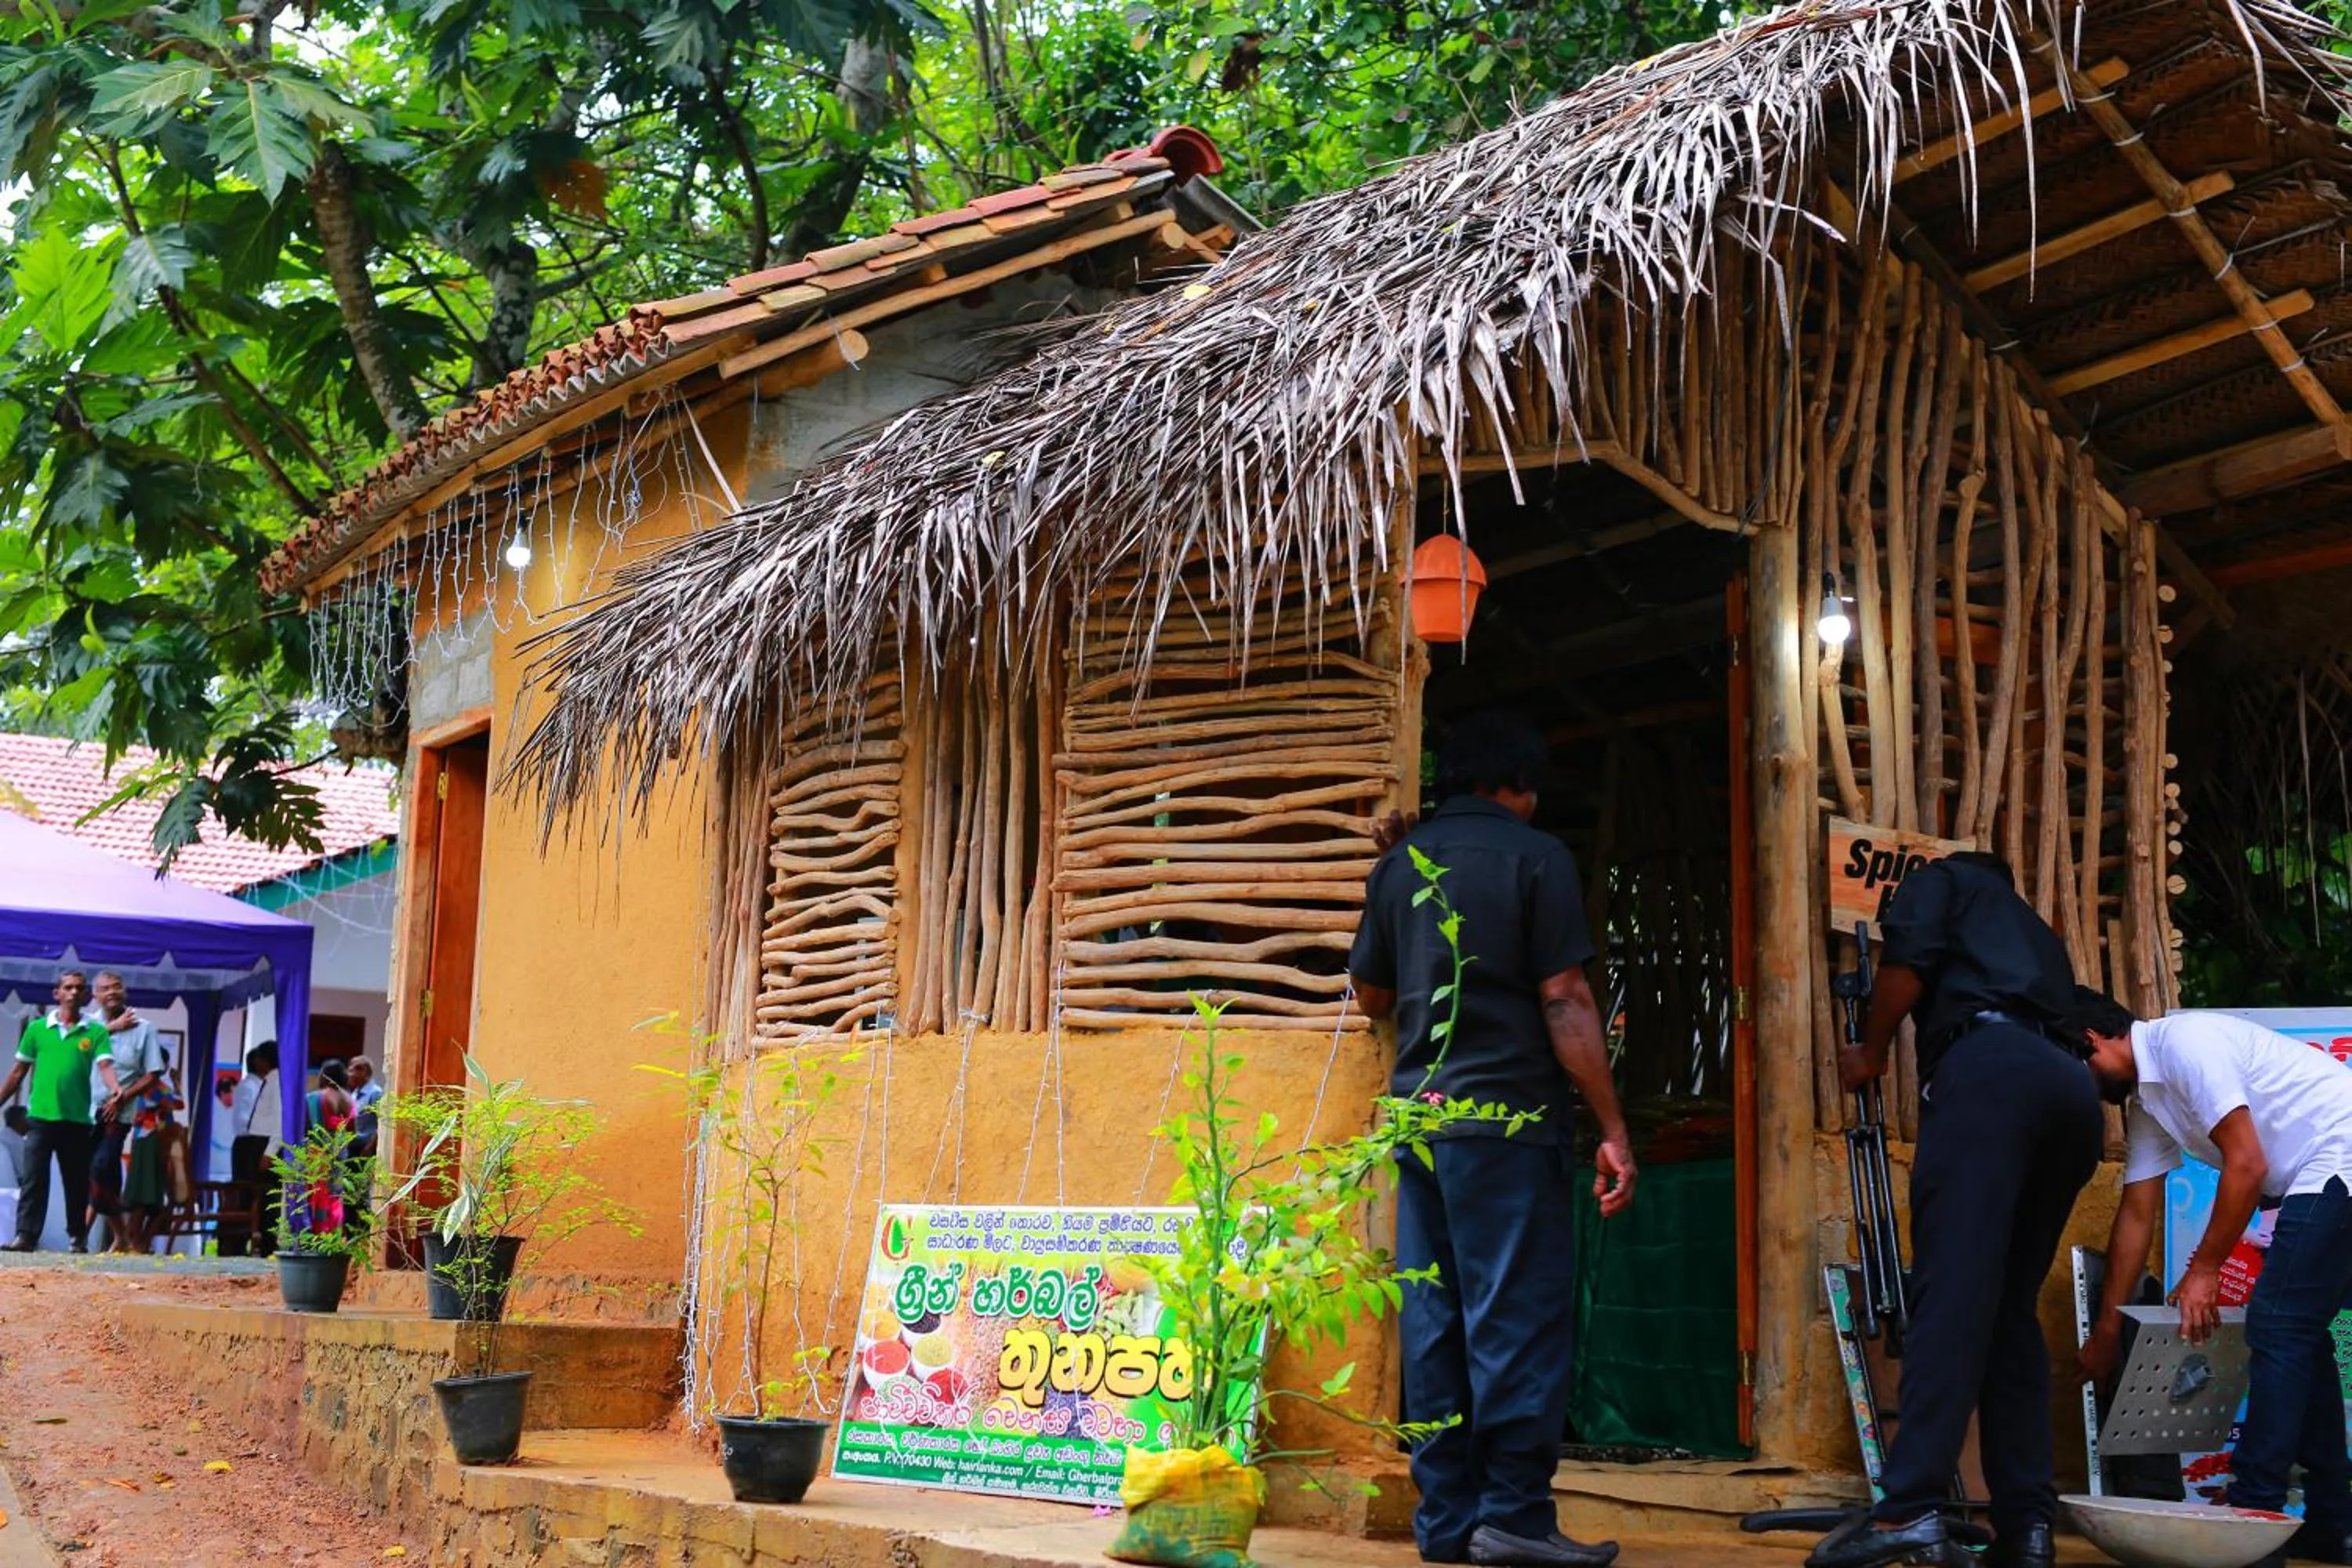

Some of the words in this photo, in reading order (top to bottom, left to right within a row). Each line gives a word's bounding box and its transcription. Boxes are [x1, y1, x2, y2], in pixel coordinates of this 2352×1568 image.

[1845, 839, 1943, 888] Spic
[973, 1265, 1102, 1329] හර්බල්
[1036, 1465, 1065, 1480] Email:
